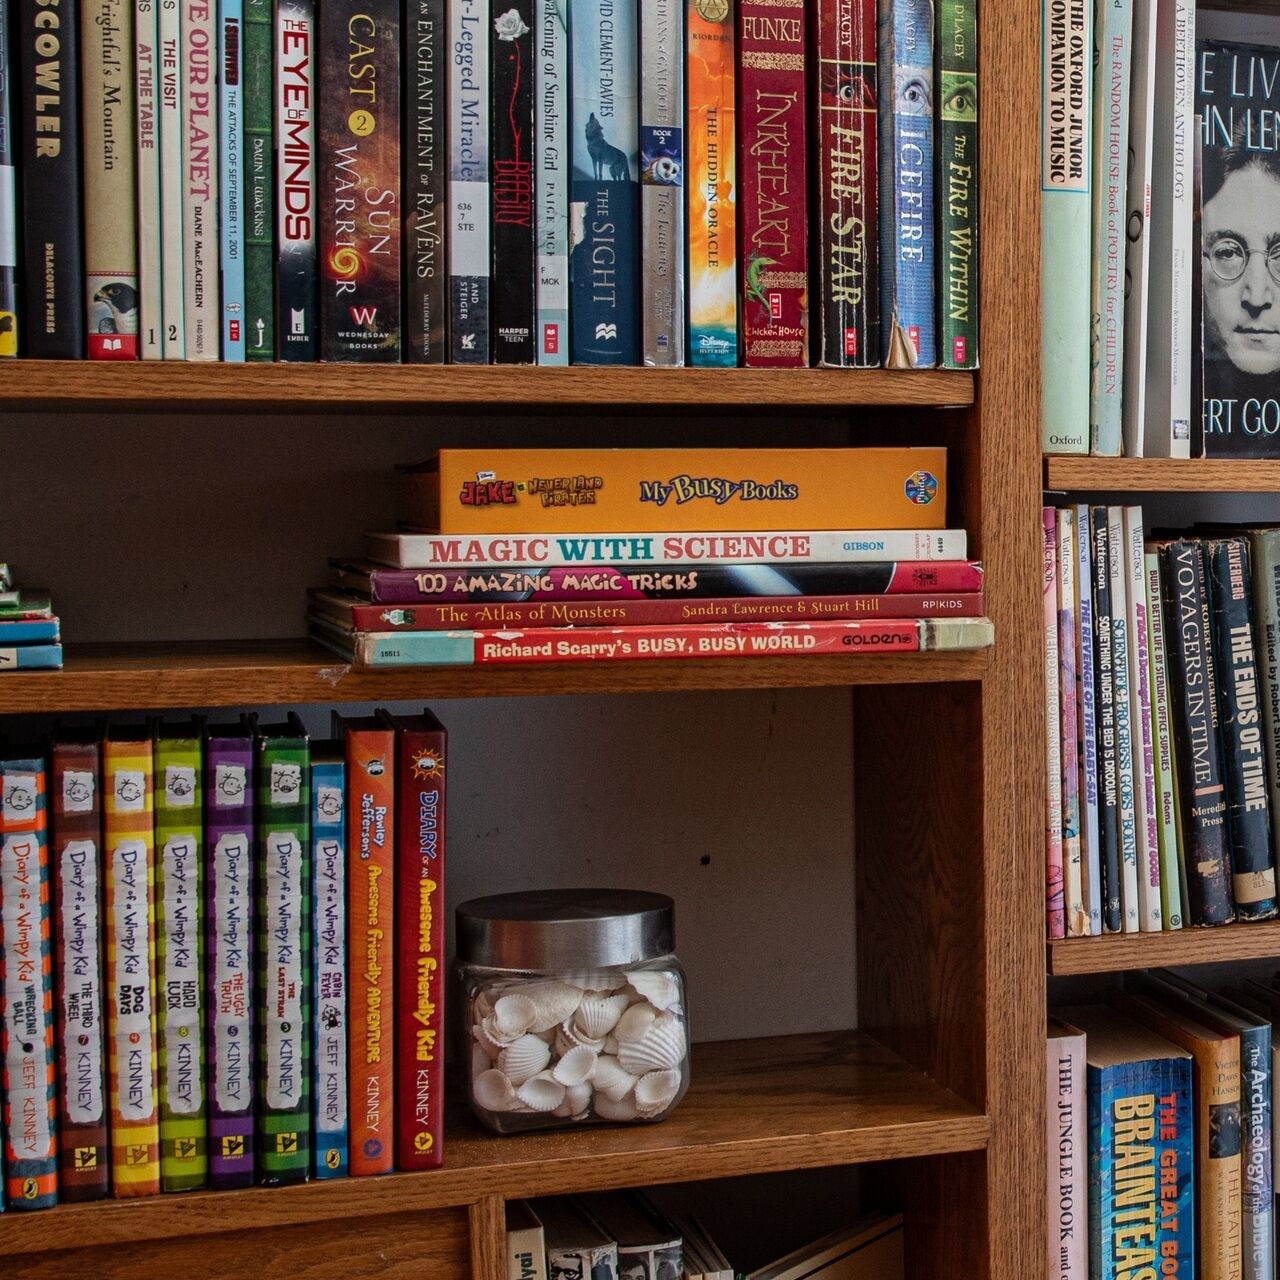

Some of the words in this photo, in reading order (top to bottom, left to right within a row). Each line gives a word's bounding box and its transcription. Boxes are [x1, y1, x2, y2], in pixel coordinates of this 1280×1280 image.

[420, 2, 427, 14] AN
[742, 17, 801, 42] FUNKE
[139, 43, 152, 65] AT
[139, 68, 153, 96] THE
[189, 29, 209, 85] OUR
[348, 14, 376, 103] CAST
[599, 16, 614, 118] CLEMENT-DAVIES
[1070, 35, 1083, 110] OXFORD
[140, 98, 154, 149] TABLE
[417, 19, 433, 171] ENCHANTMENT
[707, 108, 717, 138] THE
[1050, 98, 1066, 122] TO
[190, 91, 210, 202] PLANET
[707, 142, 717, 202] HIDDEN
[749, 89, 797, 256] INKHEART
[830, 124, 862, 204] FIRE
[955, 135, 966, 160] THE
[1050, 126, 1065, 184] MUSIC
[1069, 114, 1083, 180] JUNIOR
[420, 174, 428, 185] OF
[597, 189, 609, 217] THE
[900, 129, 928, 264] ICEFIRE
[948, 161, 971, 218] FIRE
[365, 184, 395, 257] SUN
[416, 192, 441, 279] RAVENS
[457, 223, 475, 231] STE
[707, 205, 718, 268] ORACLE
[541, 278, 559, 286] MCK
[592, 222, 616, 307] SIGHT
[830, 212, 864, 305] STAR
[948, 227, 971, 322] WITHIN
[1049, 434, 1082, 446] Oxford
[639, 482, 671, 505] My
[671, 473, 739, 505] Busy
[739, 480, 799, 503] Books
[428, 538, 550, 564] MAGIC
[557, 536, 655, 561] WITH
[663, 534, 810, 559] SCIENCE
[842, 540, 885, 551] GIBSON
[436, 606, 470, 622] The
[475, 605, 524, 624] Atlas
[529, 604, 546, 621] of
[552, 604, 626, 621] Monsters
[1176, 550, 1203, 687] VOYAGERS
[1188, 688, 1203, 715] IN
[1190, 719, 1211, 785] TIME
[420, 790, 438, 858] DIARY
[177, 1044, 192, 1103] KINNEY
[415, 1028, 436, 1062] Kid
[76, 1052, 93, 1112] KINNEY
[1059, 1055, 1072, 1095] THE
[1057, 1101, 1073, 1177] JUNGLE
[1059, 1181, 1074, 1242] BOOK
